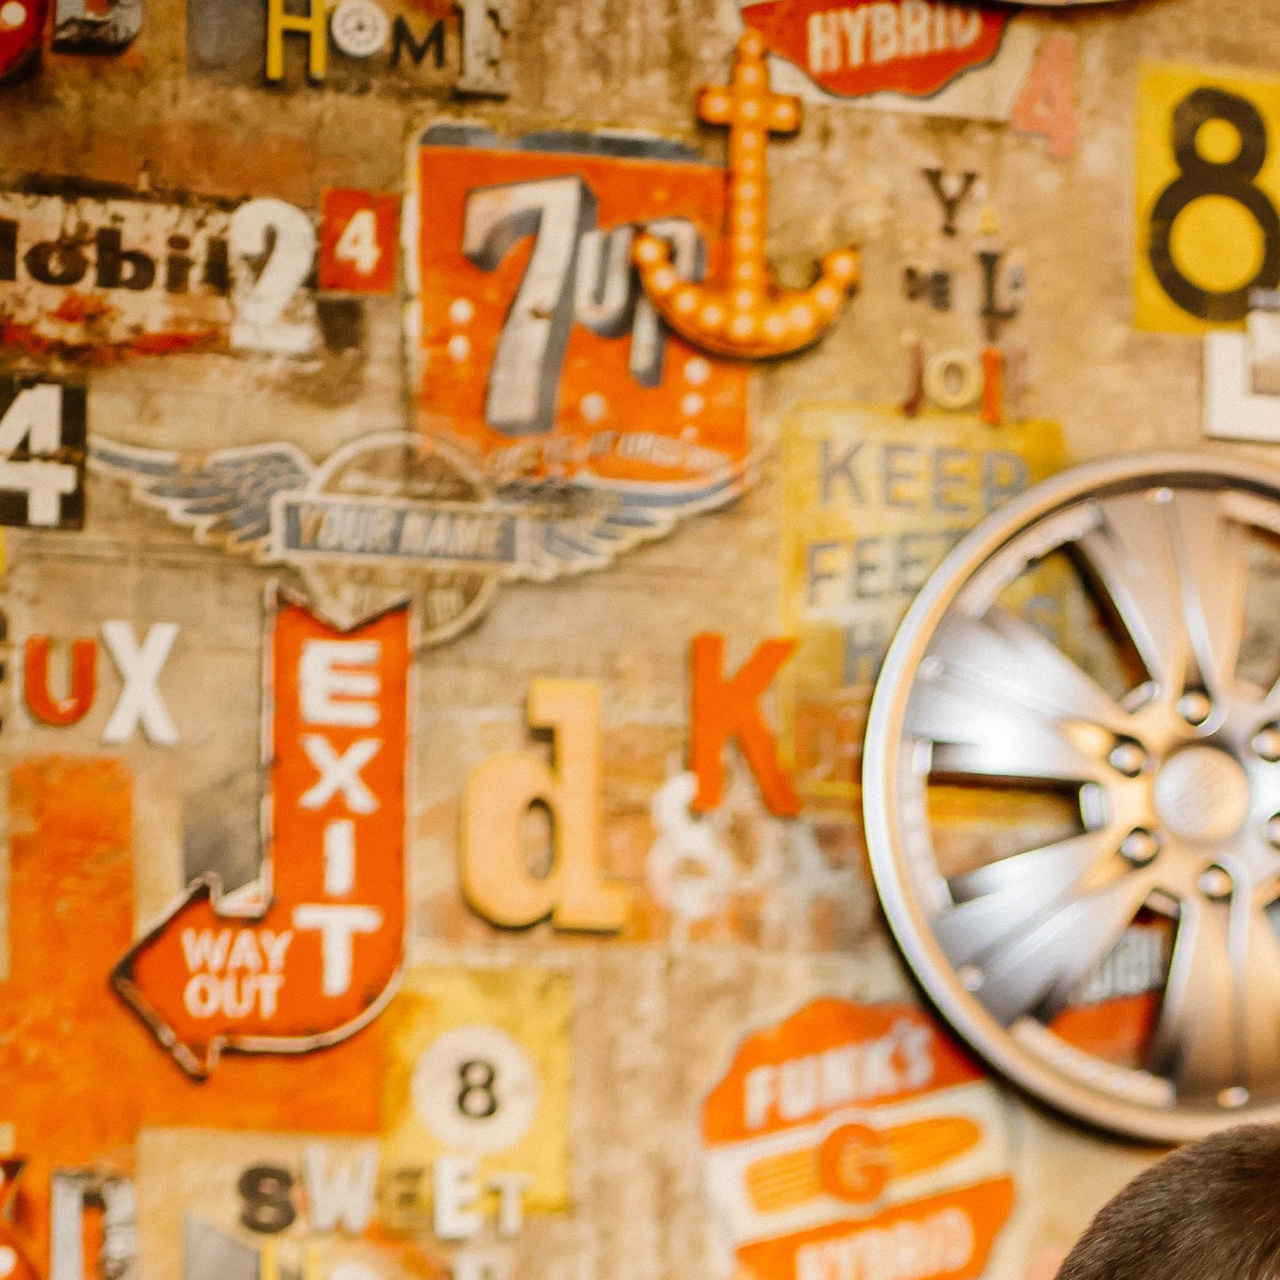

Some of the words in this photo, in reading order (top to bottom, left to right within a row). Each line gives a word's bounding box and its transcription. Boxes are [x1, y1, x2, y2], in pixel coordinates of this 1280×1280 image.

[807, 0, 982, 73] HYBRID
[0, 218, 230, 293] obil
[804, 528, 968, 606] FEE
[688, 630, 800, 816] K
[293, 637, 384, 998] EXIT
[181, 927, 293, 975] WAY
[183, 972, 284, 1020] OUT
[455, 1057, 500, 1120] 8
[238, 1142, 536, 1240] SWEET
